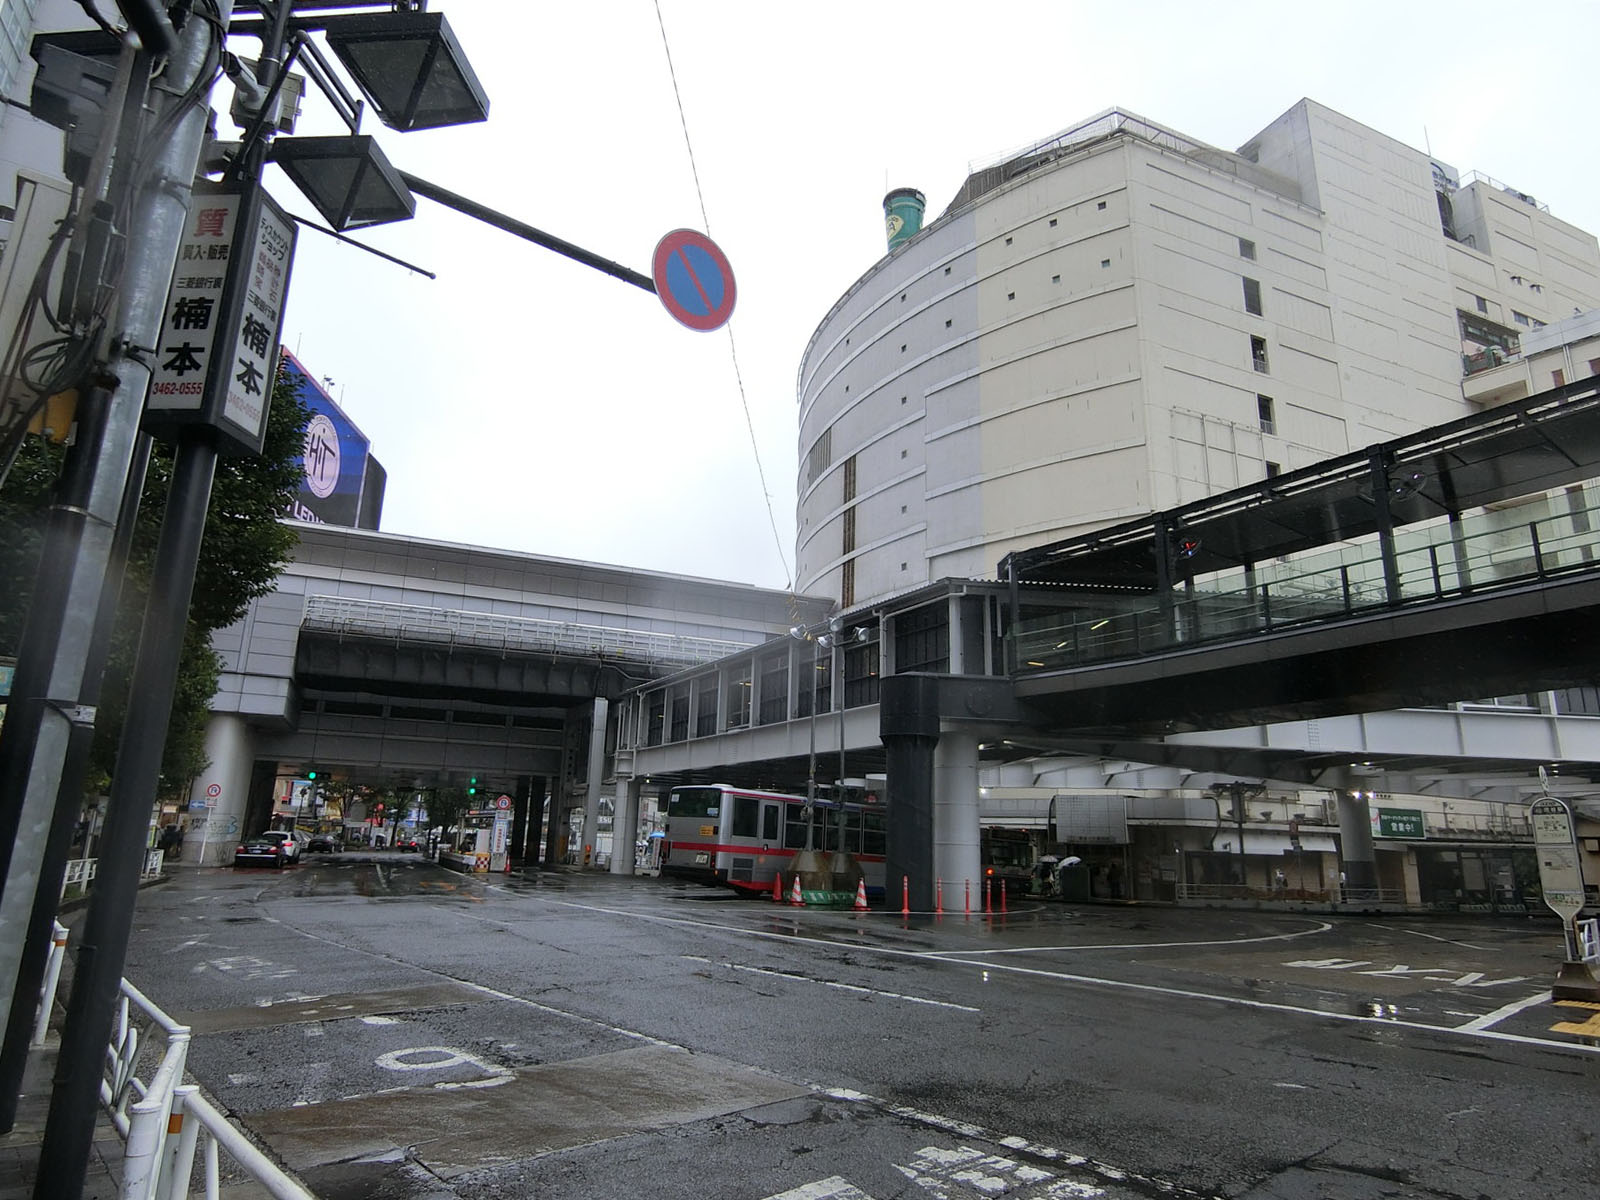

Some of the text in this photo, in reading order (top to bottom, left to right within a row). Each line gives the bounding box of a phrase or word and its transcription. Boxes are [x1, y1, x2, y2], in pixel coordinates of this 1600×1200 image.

[193, 208, 229, 237] 質
[162, 296, 215, 377] 楠本
[236, 312, 272, 397] 楠本
[152, 382, 203, 395] 3462-0555
